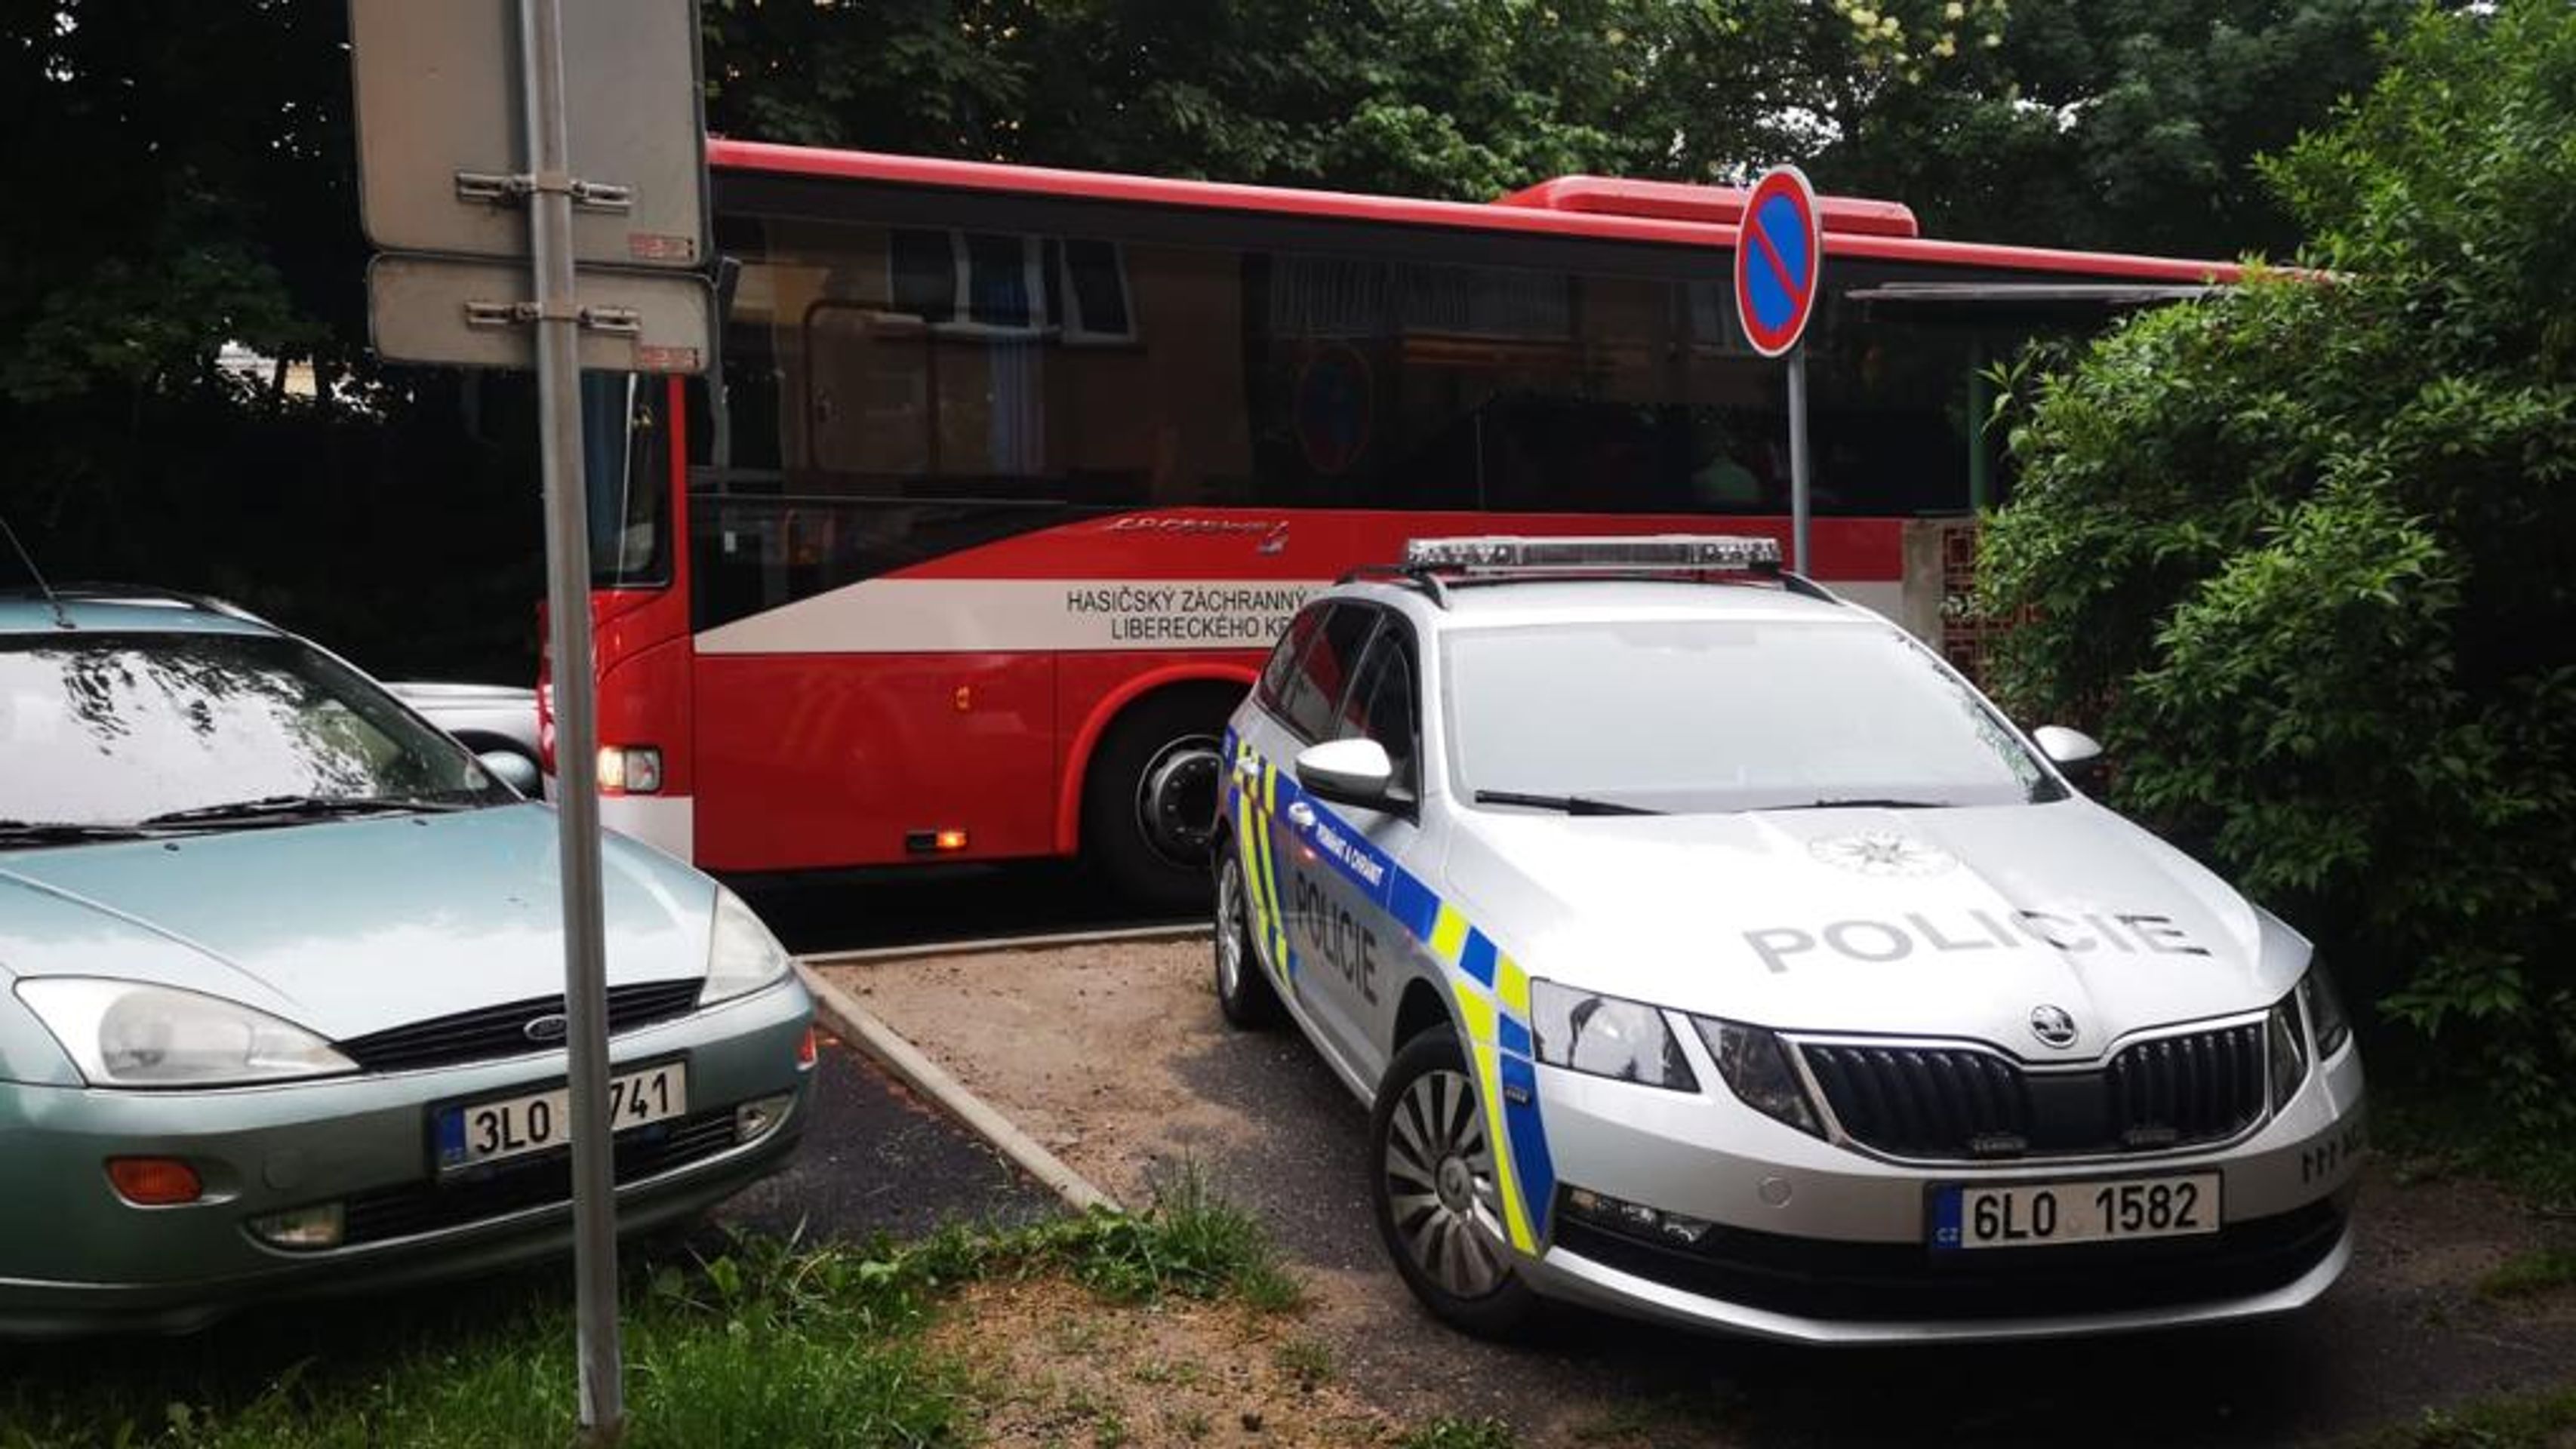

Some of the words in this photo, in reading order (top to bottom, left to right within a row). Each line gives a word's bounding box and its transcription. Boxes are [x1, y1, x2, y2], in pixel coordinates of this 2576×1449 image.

[1066, 586, 1174, 612] HASIČSKÝ
[1181, 586, 1308, 612] ZÁCHRANNÝ
[1112, 613, 1259, 639] LIBERECKÉHO
[1265, 615, 1291, 638] KR
[1295, 873, 1378, 1007] POLICIE
[1741, 909, 2211, 974] POLICIE
[475, 1099, 550, 1155] 3L0
[609, 1071, 669, 1126] 741
[1974, 1190, 2057, 1241] 6L0
[2095, 1182, 2199, 1233] 1582
